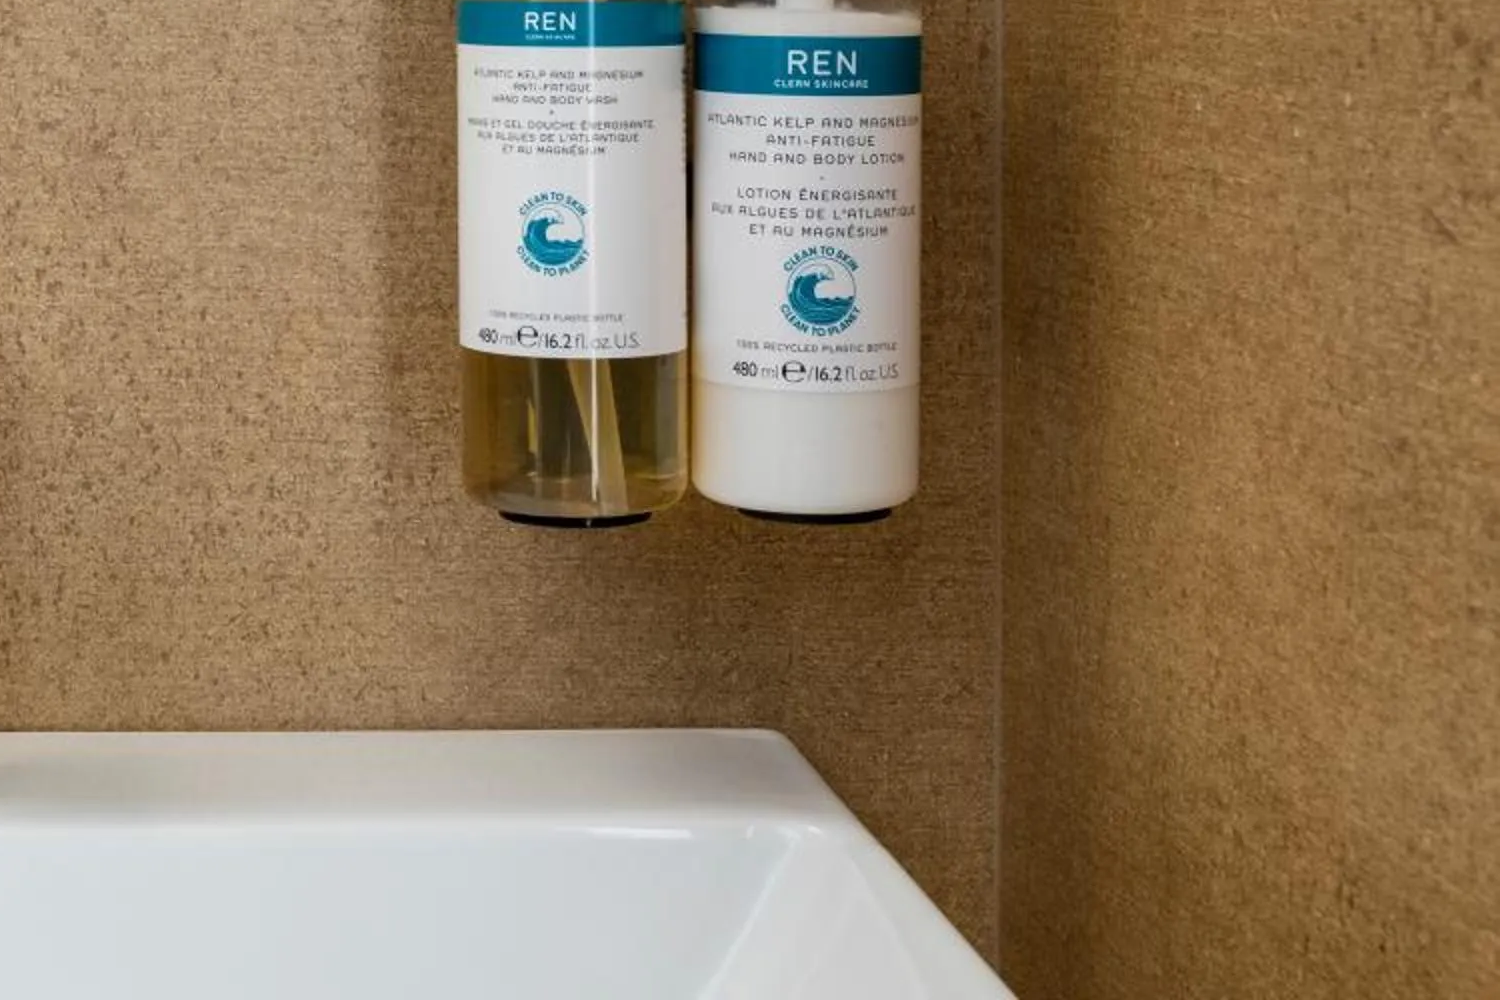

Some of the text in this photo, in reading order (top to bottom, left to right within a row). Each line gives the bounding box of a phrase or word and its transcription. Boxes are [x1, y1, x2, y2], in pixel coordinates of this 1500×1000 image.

[524, 11, 577, 31] REN
[787, 49, 858, 76] REN
[517, 69, 546, 80] KELP
[549, 70, 575, 80] AND
[773, 79, 869, 89] CLEAN SKINCARE
[522, 96, 546, 105] AND
[550, 96, 583, 105] BODY
[504, 120, 522, 130] GEL
[527, 121, 575, 131] DOUCHE
[708, 113, 767, 127] ATLANTIC
[773, 116, 815, 129] KELP
[821, 117, 853, 129] AND
[766, 134, 876, 148] ANTI-FATIGUE
[729, 153, 905, 165] HAND AND BODY LOTION
[737, 185, 897, 202] LOTION ÉNERGISANTE
[519, 191, 588, 216] CLEAN TO SKIN
[739, 205, 799, 219] ALGUES
[805, 207, 825, 220] DE
[749, 223, 888, 238] ET AU MAGNÉSIUM
[783, 246, 859, 272] CLEAN TO SKIN
[543, 267, 557, 277] TO
[780, 303, 861, 337] CLEAN TO PLANET
[732, 361, 757, 377] 480
